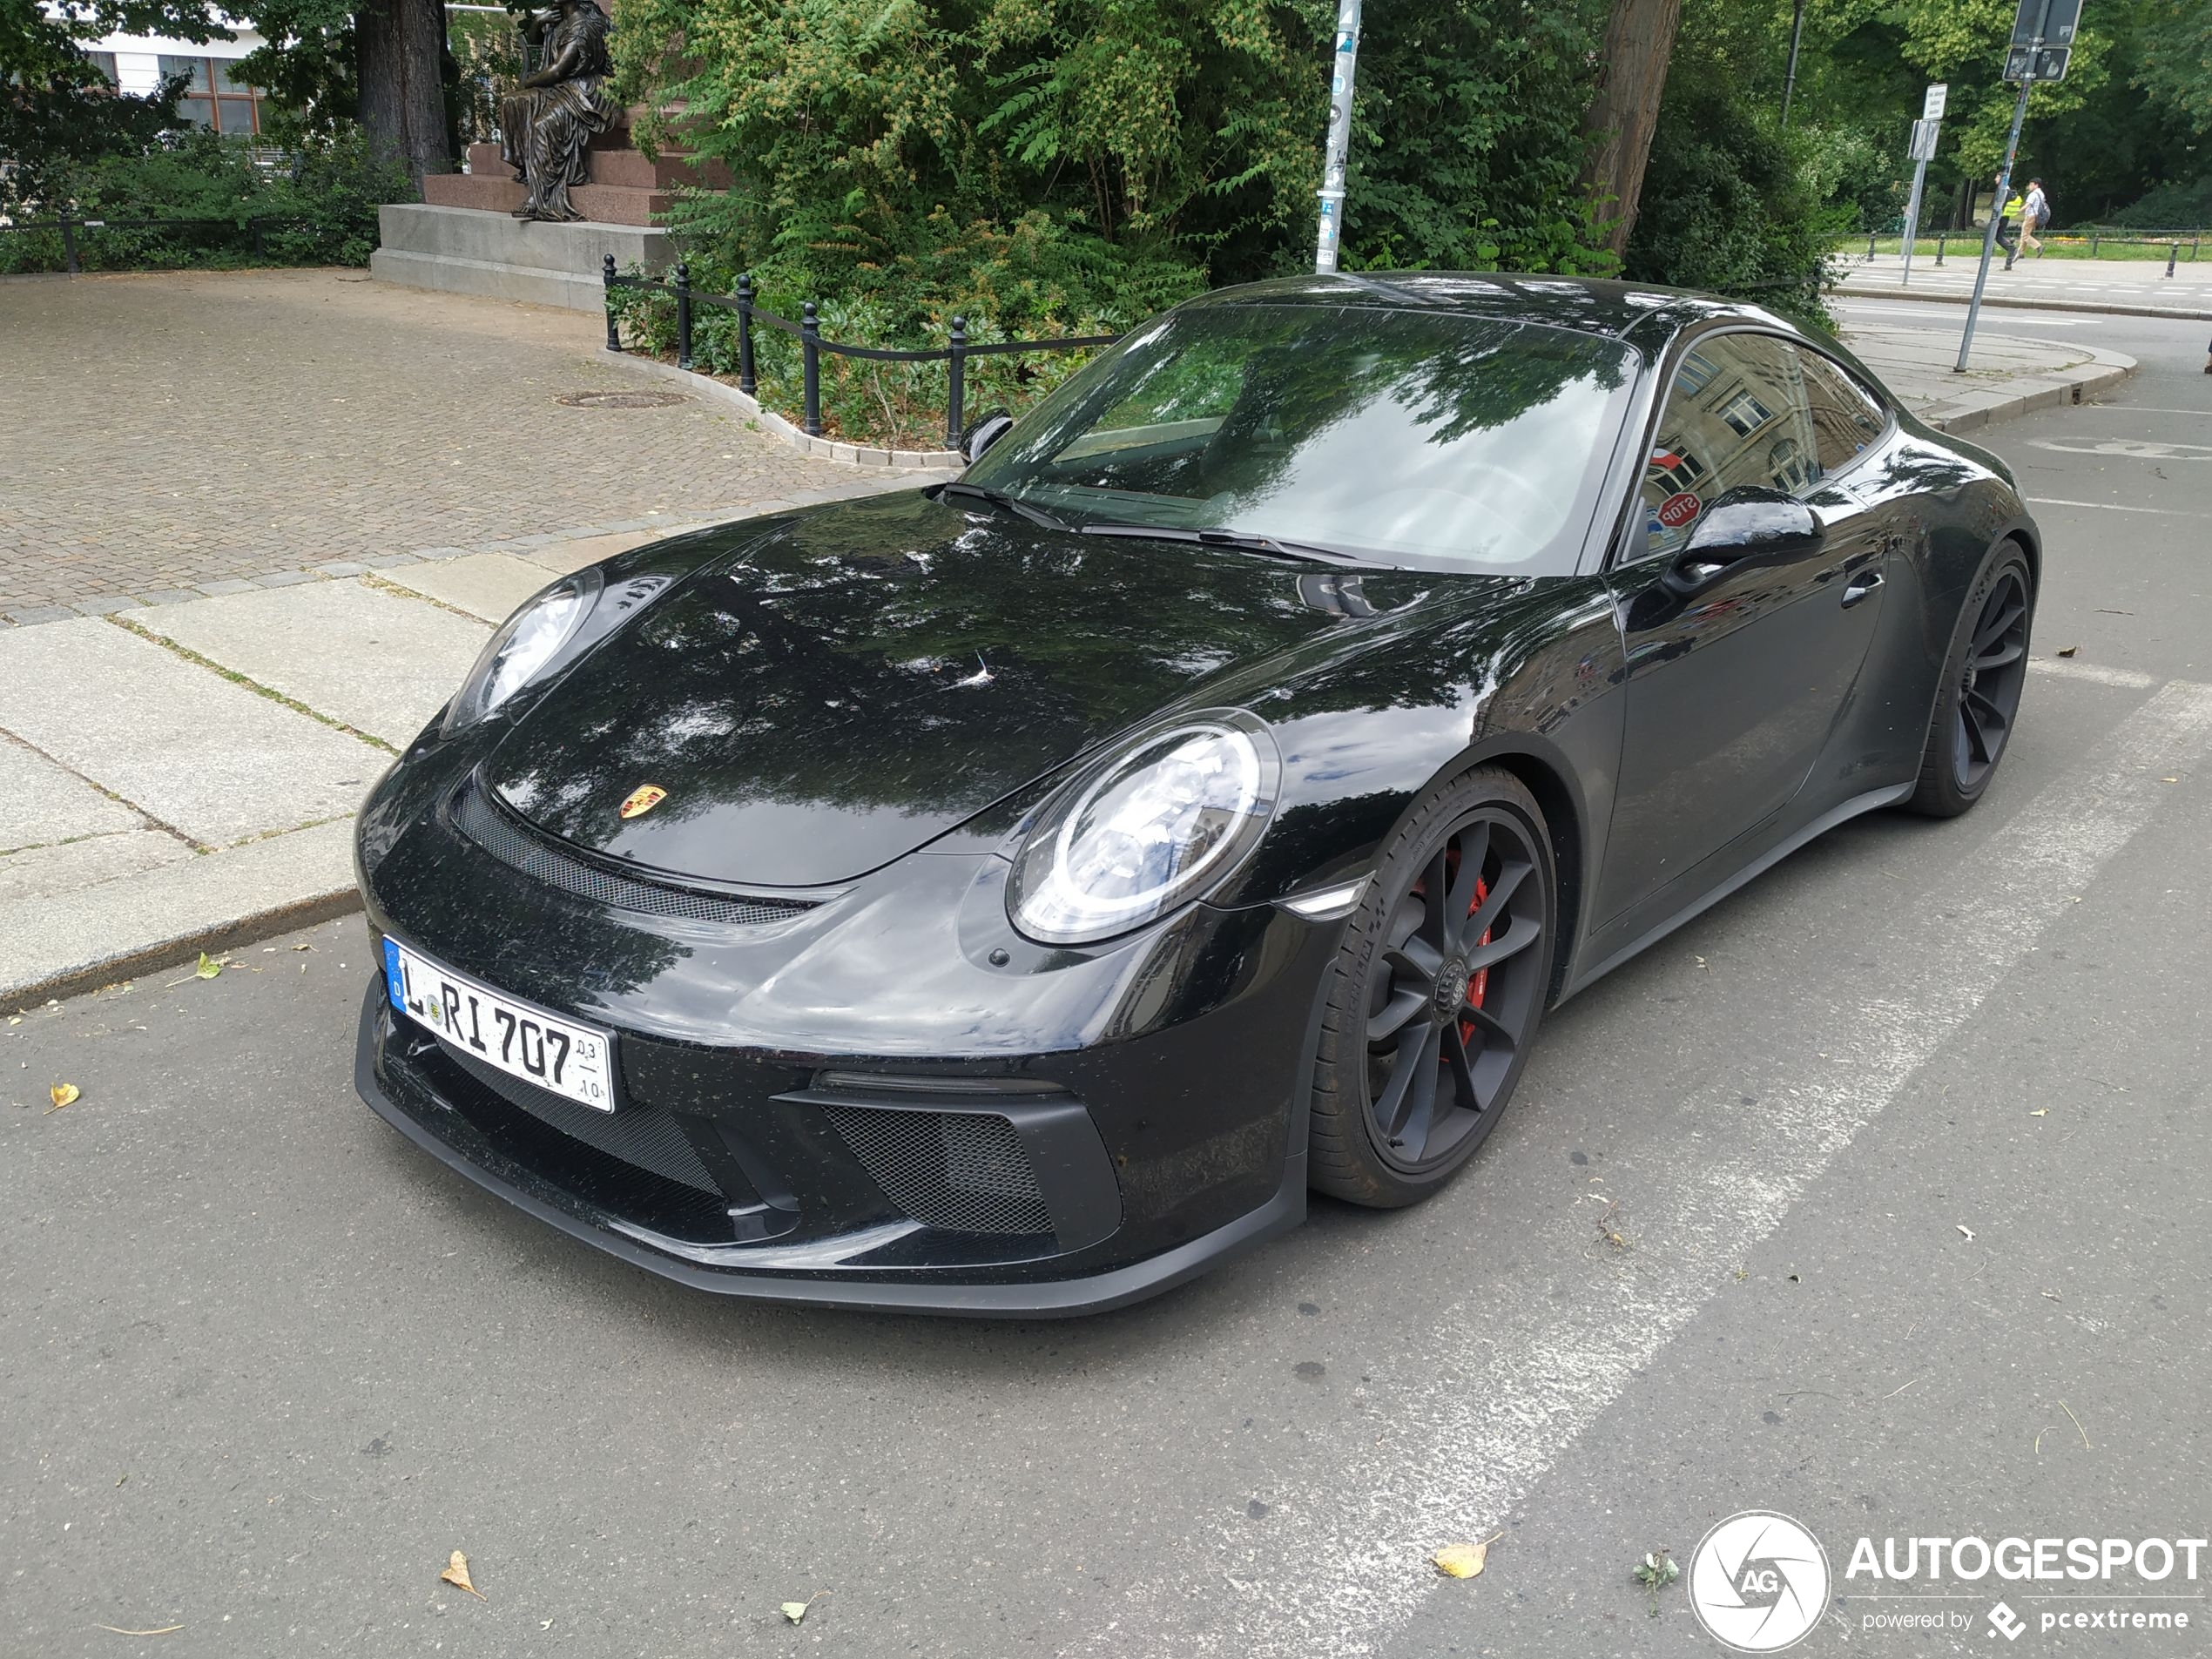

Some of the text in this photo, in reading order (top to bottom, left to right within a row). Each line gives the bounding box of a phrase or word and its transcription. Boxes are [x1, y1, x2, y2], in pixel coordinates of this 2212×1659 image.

[394, 981, 401, 996] D
[402, 958, 424, 1016] L
[494, 1007, 570, 1085] 707
[577, 1039, 596, 1058] 03
[582, 1079, 599, 1097] 10
